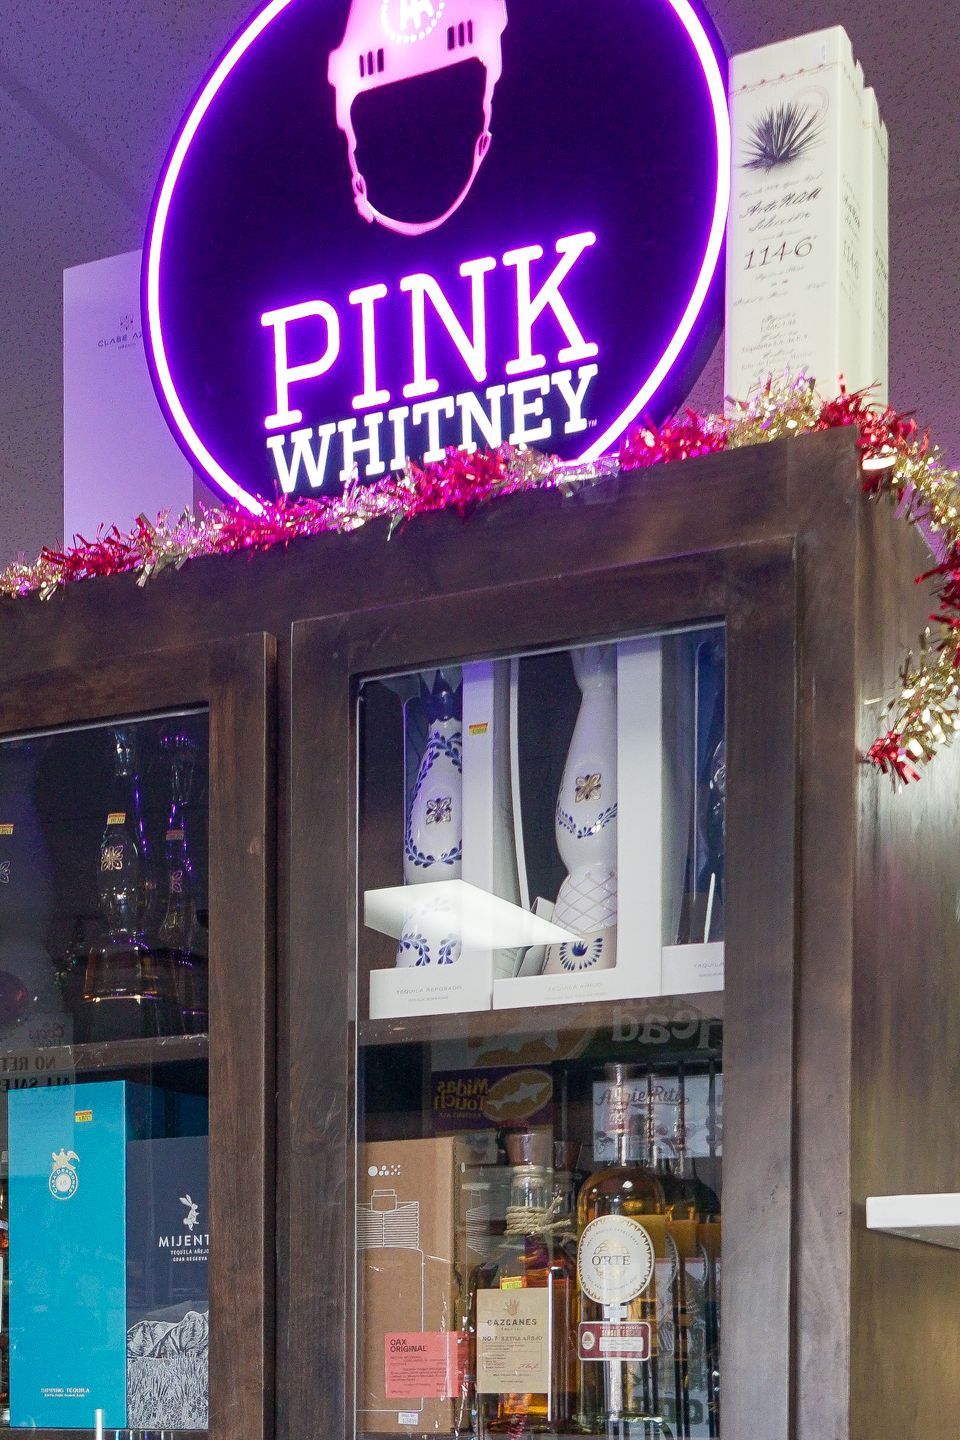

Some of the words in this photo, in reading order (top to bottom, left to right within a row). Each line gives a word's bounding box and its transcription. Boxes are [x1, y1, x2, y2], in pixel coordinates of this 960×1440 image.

[261, 231, 598, 430] PINK
[266, 364, 598, 492] WHITNEY
[390, 1345, 427, 1353] ORIGINAL
